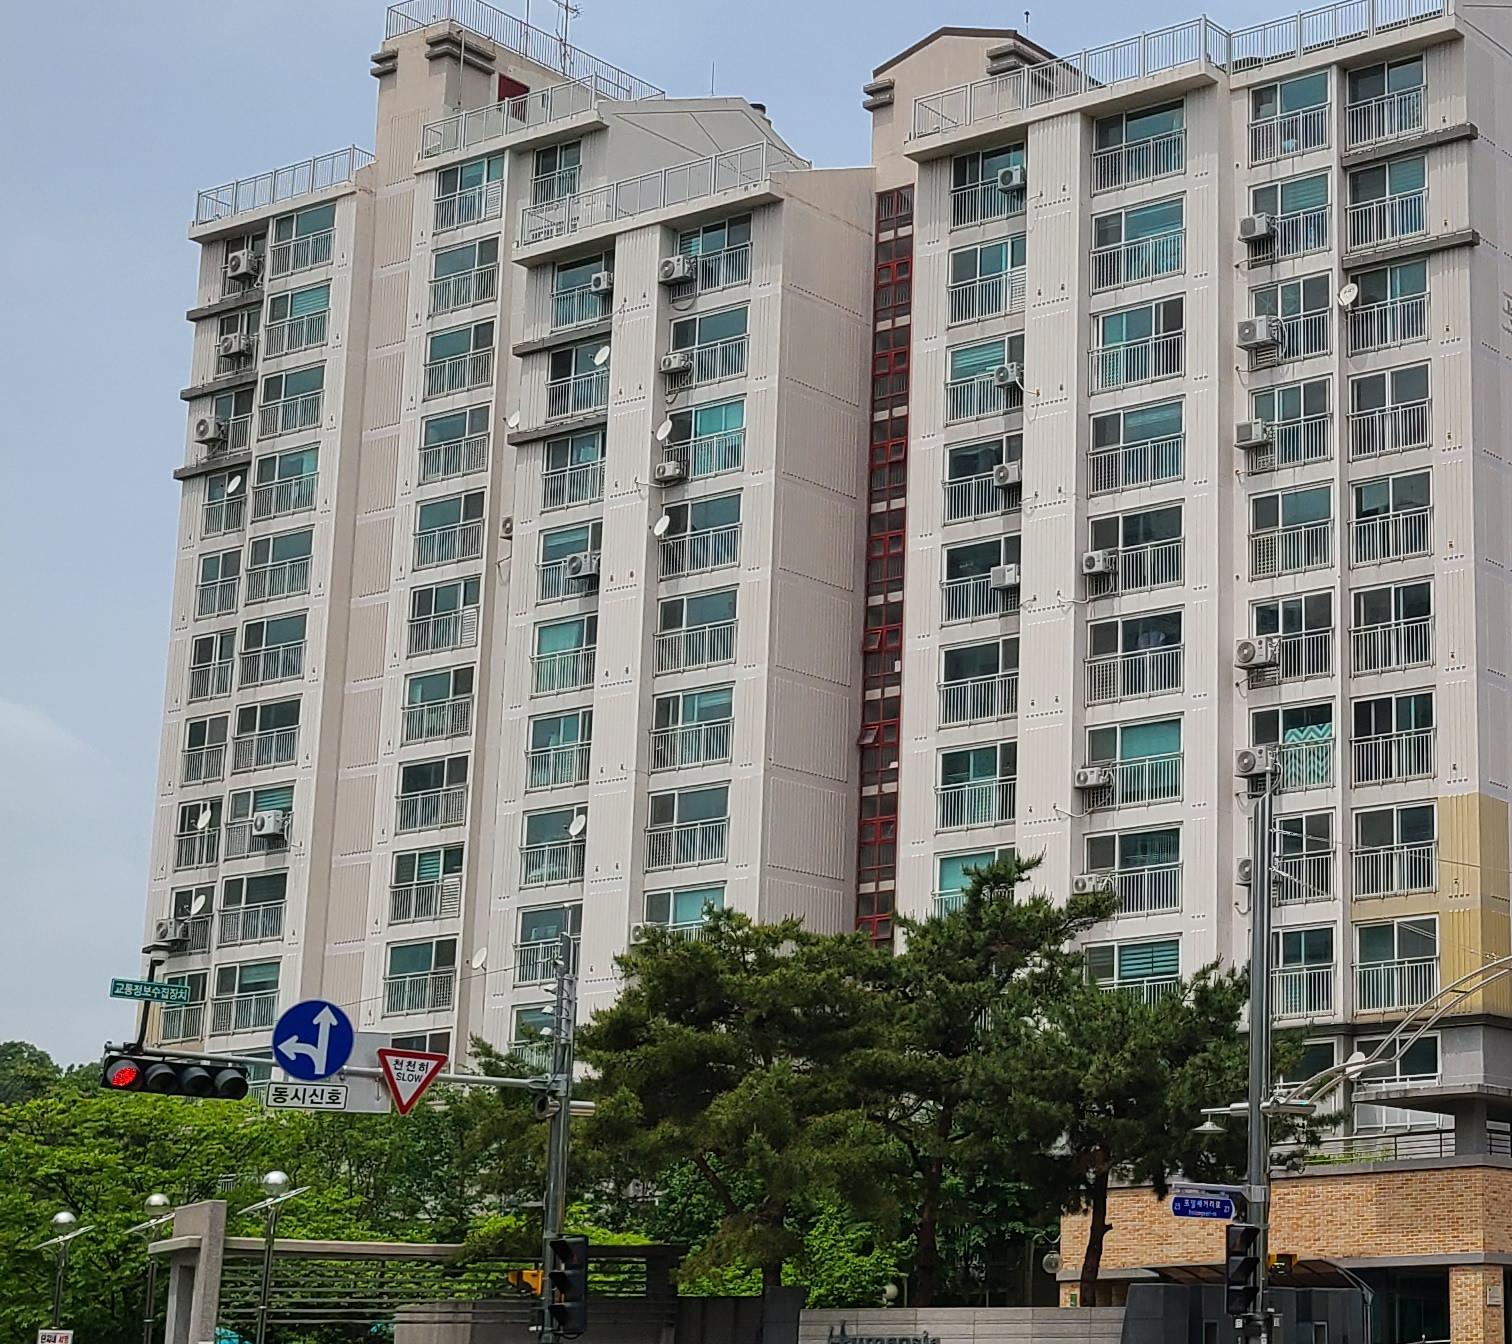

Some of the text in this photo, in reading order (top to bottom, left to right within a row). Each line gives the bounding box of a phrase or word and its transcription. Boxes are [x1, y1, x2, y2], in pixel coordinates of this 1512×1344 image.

[114, 982, 187, 1001] 교통정보수집장치
[393, 1058, 430, 1074] 천천히
[395, 1073, 424, 1083] SLOW
[271, 1086, 342, 1105] 동시신호
